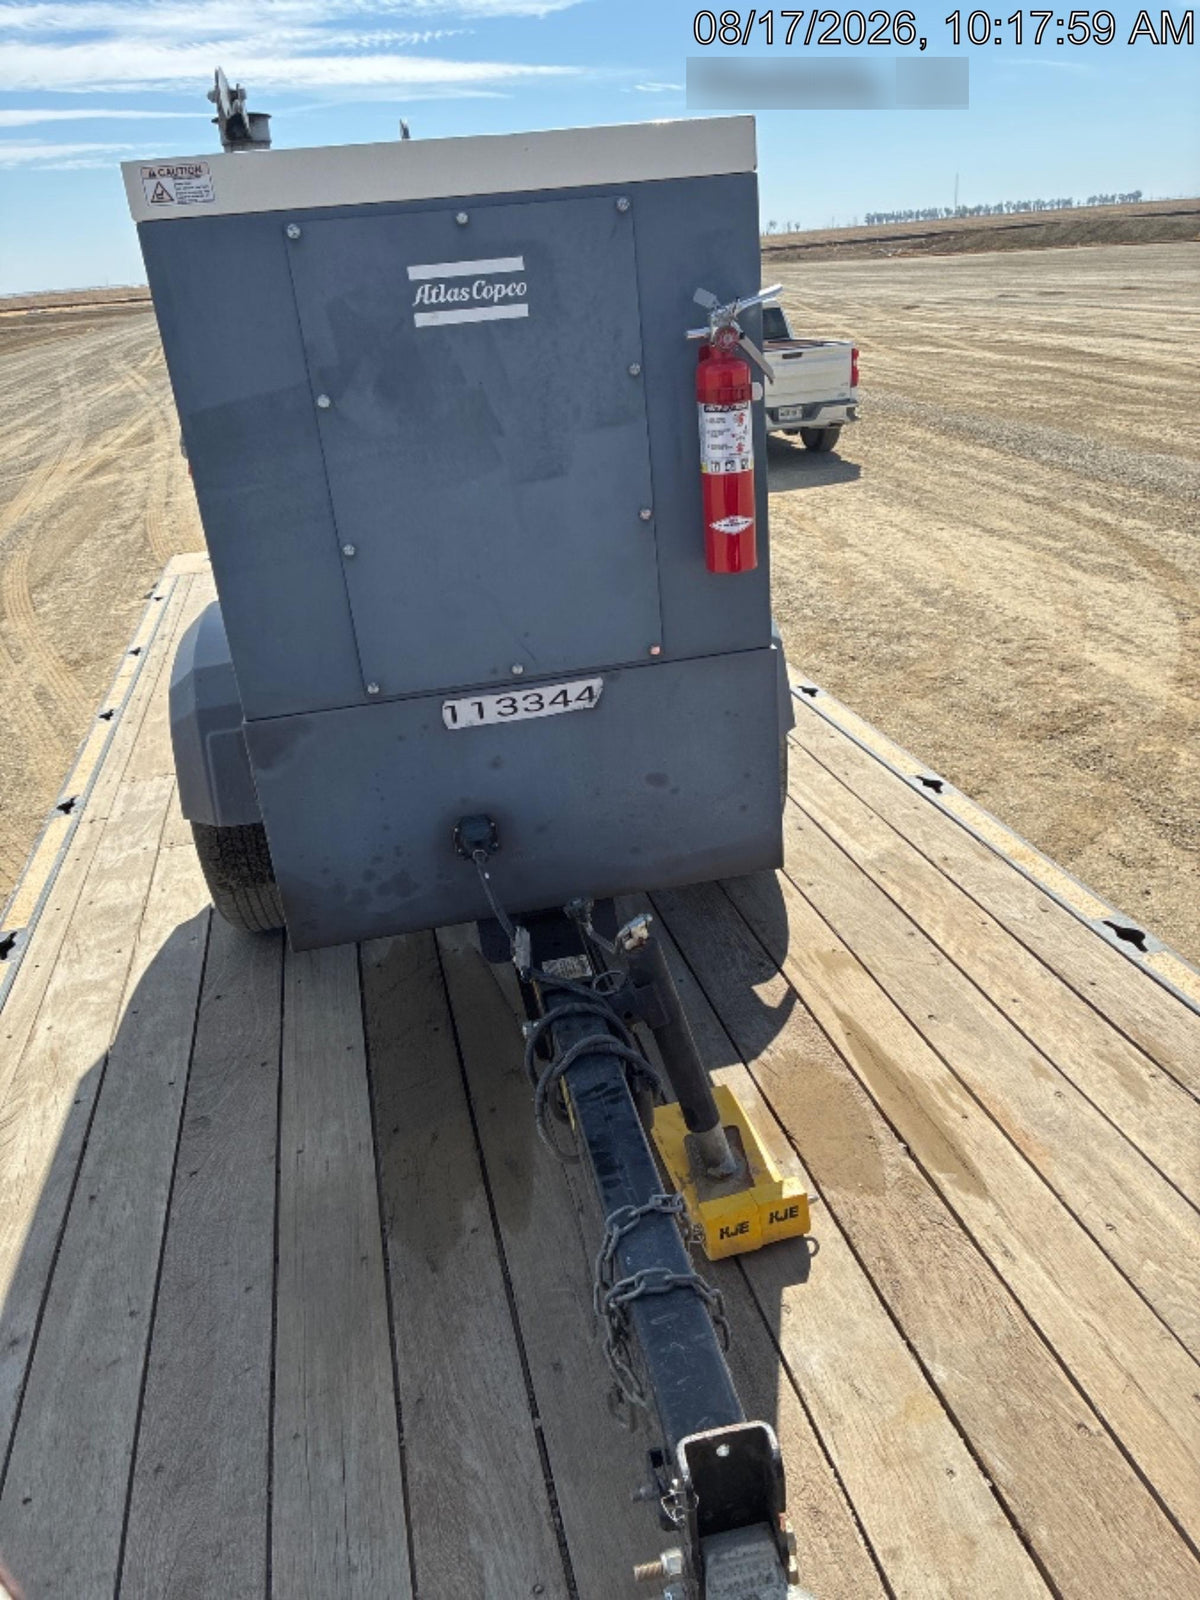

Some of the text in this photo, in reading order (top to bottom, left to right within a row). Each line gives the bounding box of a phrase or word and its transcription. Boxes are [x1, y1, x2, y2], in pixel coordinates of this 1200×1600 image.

[157, 165, 203, 177] CAUTION
[412, 280, 527, 307] Atlas Copco
[444, 685, 596, 724] 113344
[769, 1205, 799, 1224] KJE
[720, 1221, 749, 1240] KJE
